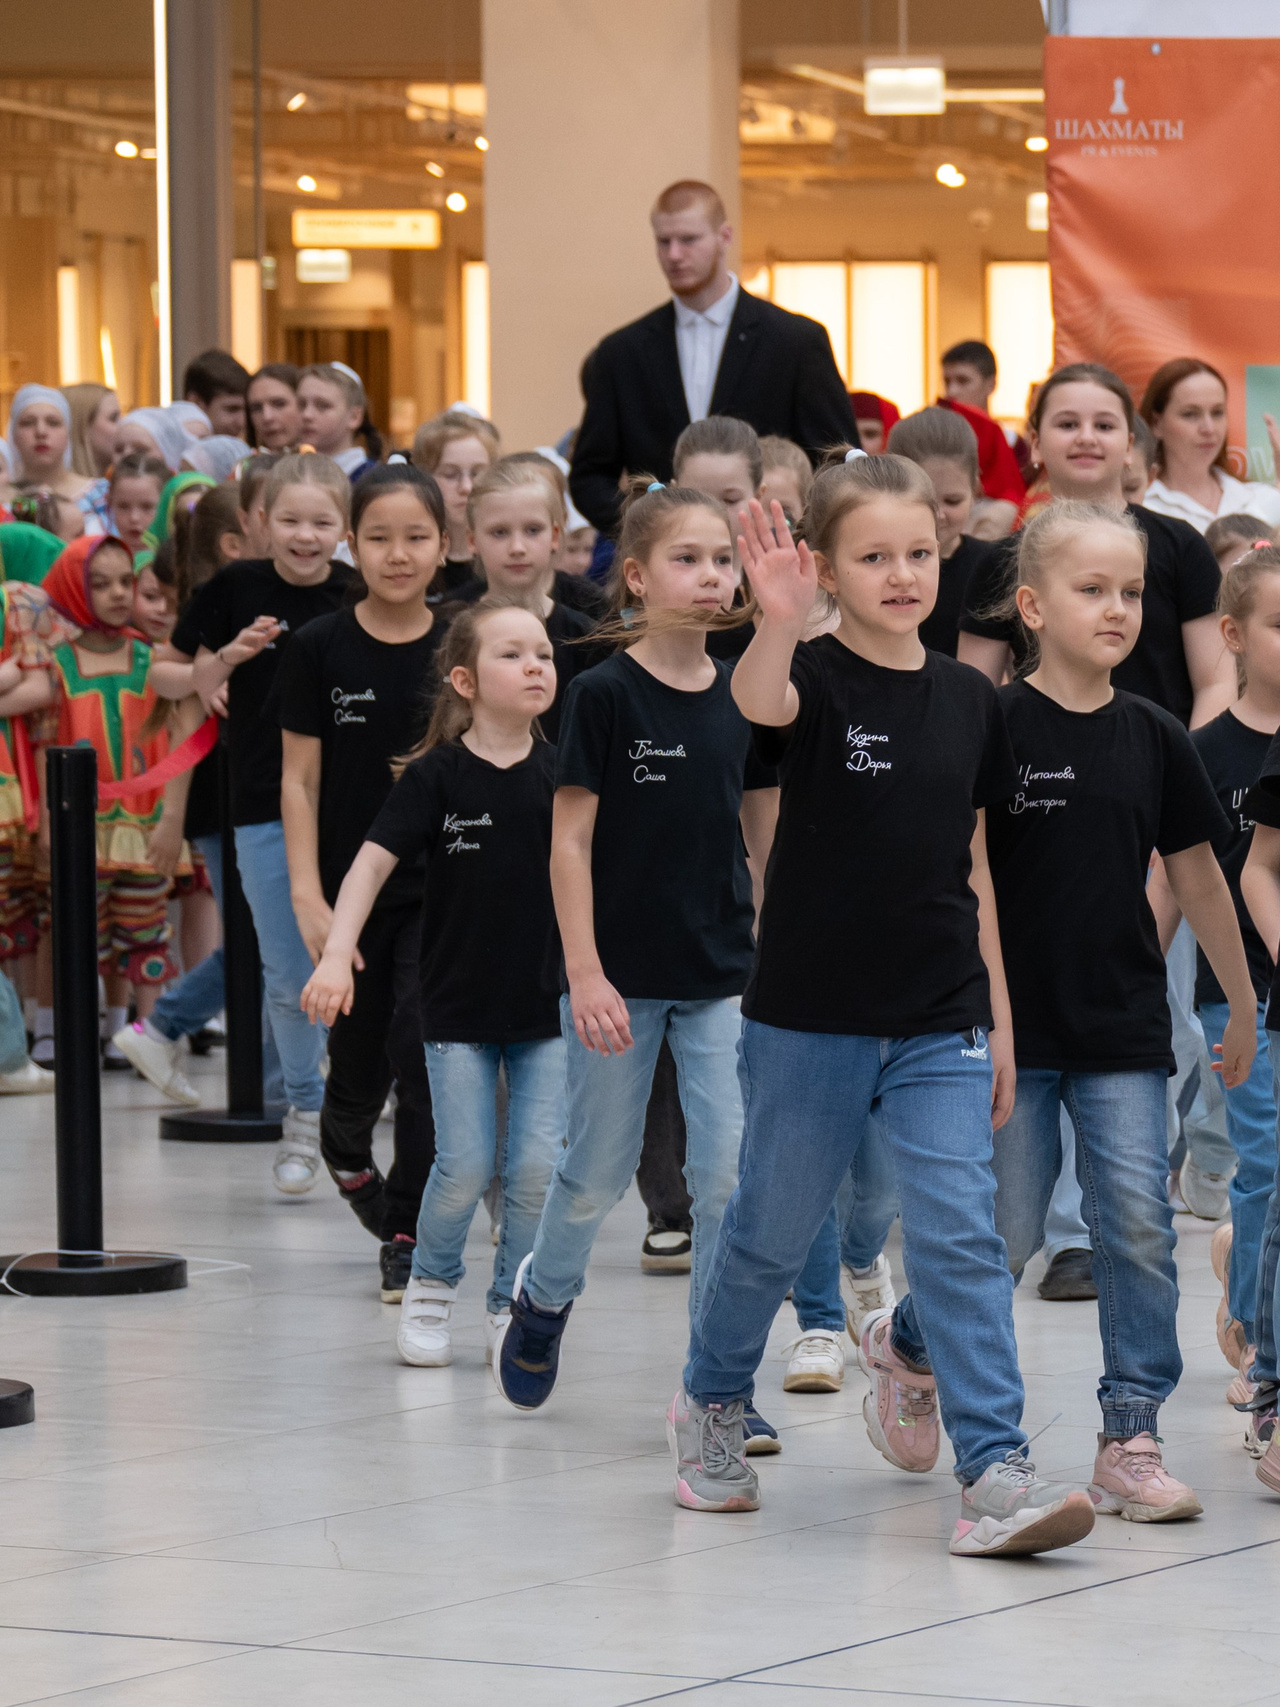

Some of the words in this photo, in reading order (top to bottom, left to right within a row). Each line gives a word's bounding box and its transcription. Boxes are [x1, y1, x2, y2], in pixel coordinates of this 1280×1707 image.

[1054, 119, 1184, 140] ШАХМАТЫ
[846, 724, 889, 748] Кудина
[628, 740, 687, 760] Балашова
[633, 764, 667, 783] Саша
[846, 750, 892, 777] Дарья
[1008, 791, 1067, 815] Виктория
